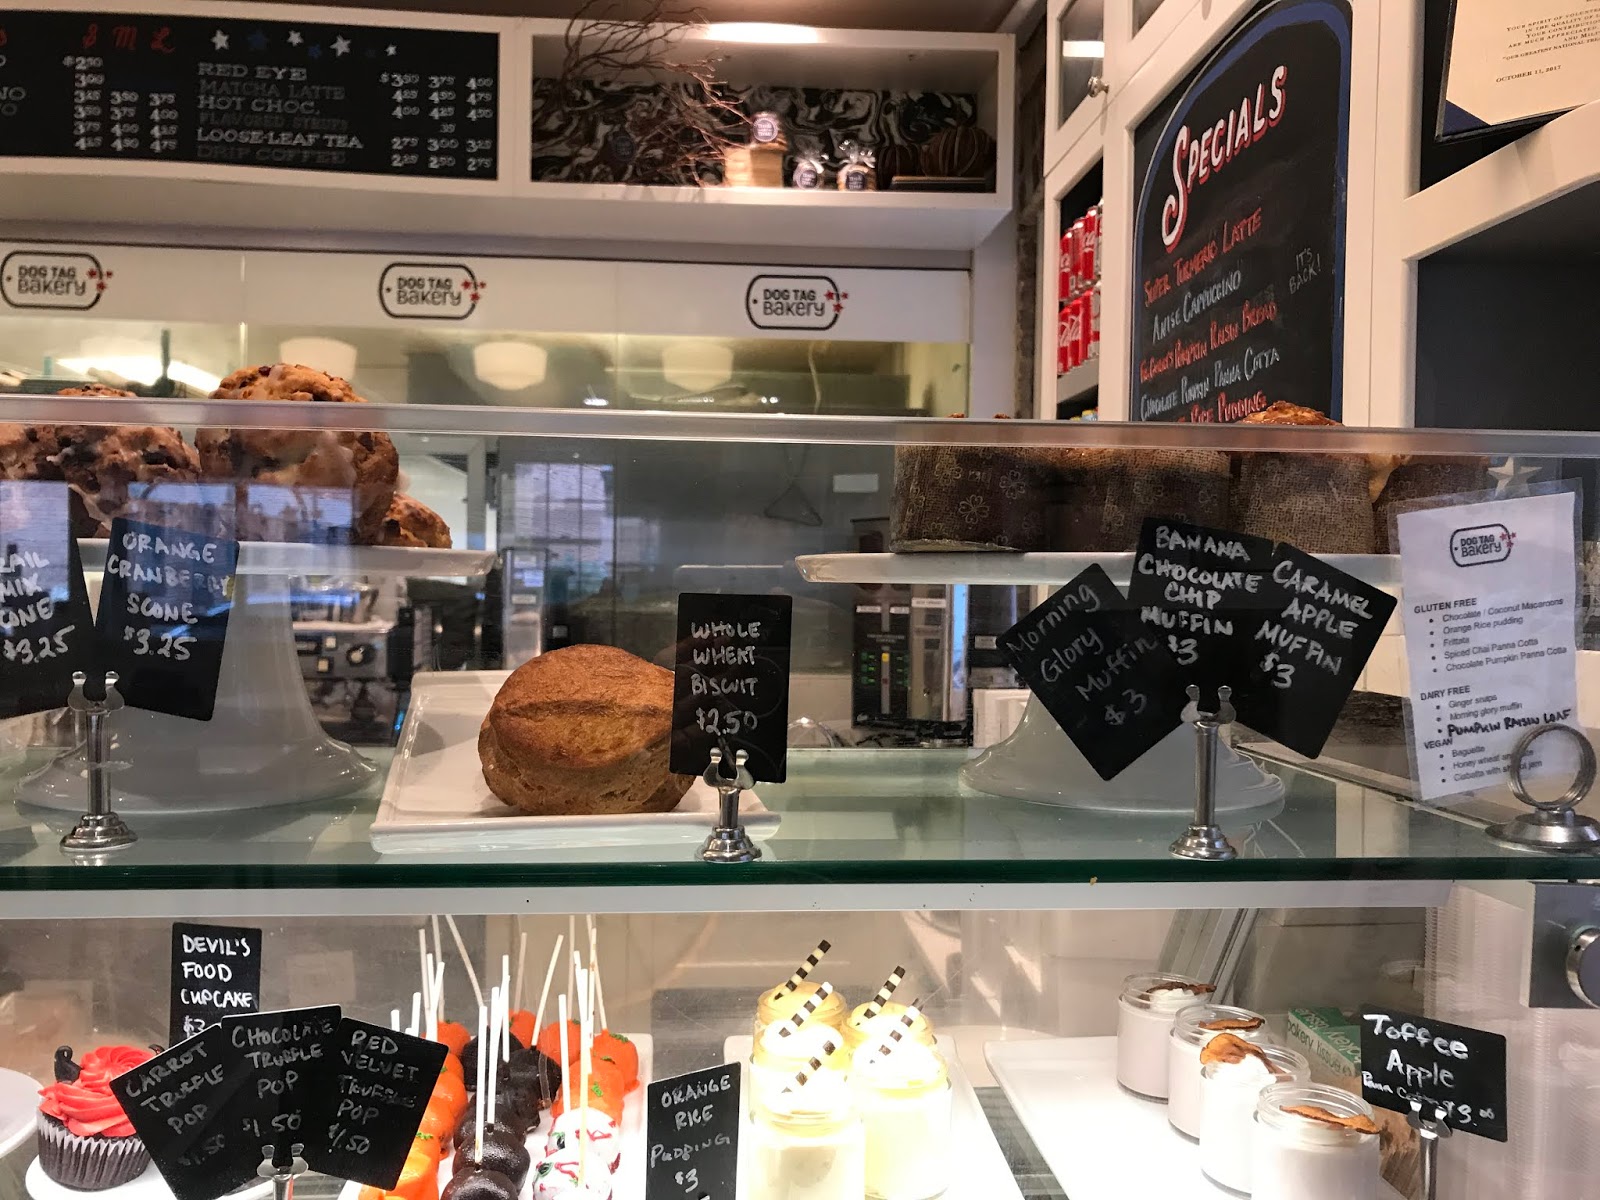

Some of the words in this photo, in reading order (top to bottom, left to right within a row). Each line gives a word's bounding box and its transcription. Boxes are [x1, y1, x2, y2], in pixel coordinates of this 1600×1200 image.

[197, 61, 248, 78] RED
[255, 65, 307, 81] EYE
[1496, 71, 1532, 83] OCTOBER
[1545, 65, 1561, 73] 2017
[197, 94, 245, 111] HOT
[199, 79, 281, 97] MATCHA
[288, 84, 346, 100] LATTE
[322, 133, 364, 149] TEA
[1162, 65, 1288, 253] SPECIALS
[1222, 207, 1262, 253] LATTE
[18, 265, 47, 278] DOG
[51, 266, 76, 280] TAG
[397, 277, 425, 290] DOG
[427, 278, 452, 290] TAG
[18, 279, 86, 296] Bakery
[396, 290, 461, 306] Bakery
[763, 289, 790, 301] DOG
[793, 290, 816, 301] TAG
[763, 301, 825, 316] Bakery
[1152, 310, 1181, 345] ANISE
[1244, 346, 1280, 382] COTTA
[122, 531, 218, 564] ORANGE
[1155, 525, 1251, 562] BANANA
[1460, 537, 1478, 546] DOG
[1479, 534, 1495, 544] TAG
[1461, 542, 1501, 557] Bakery
[1138, 553, 1263, 594] CHOCOLATE
[1164, 582, 1222, 610] CHIP
[1272, 559, 1374, 620] CARAMEL
[126, 592, 199, 625] SCONE
[1413, 601, 1451, 614] GLUTEN
[1453, 598, 1477, 609] FREE
[1442, 610, 1481, 622] Chocolate
[1487, 604, 1520, 616] Coconut
[1521, 598, 1564, 610] Macaroons
[690, 620, 761, 639] WHOLE
[1005, 582, 1100, 662] Morning
[1140, 605, 1234, 637] MUFFIN
[1281, 598, 1360, 641] APPLE
[1442, 624, 1472, 636] Orange
[1473, 619, 1492, 630] Rice
[1493, 616, 1524, 627] pudding
[3, 625, 76, 664] $3.25
[123, 625, 198, 661] $3.25
[1168, 634, 1199, 665] $3
[1254, 619, 1343, 677] MUFFIN
[1443, 637, 1470, 647] Frittata
[1444, 648, 1471, 660] Spiced
[1472, 643, 1490, 654] Chai
[1491, 641, 1516, 651] Panna
[1517, 637, 1539, 647] Cotta
[1039, 627, 1104, 684] Glory
[1075, 635, 1159, 702] Muffin
[1445, 660, 1484, 672] Chocolate
[1485, 654, 1519, 666] Pumpkin
[1520, 650, 1545, 660] Panna
[1546, 646, 1567, 655] Cotta
[1259, 652, 1296, 689] $3
[1420, 690, 1446, 701] DAIRY
[1447, 685, 1471, 696] FREE
[1448, 697, 1473, 709] Ginger
[1474, 694, 1498, 705] snaps
[695, 707, 758, 736] $2.50
[1447, 722, 1501, 737] PUMPKIN
[1503, 716, 1540, 730] RAISIN
[1543, 709, 1572, 723] LOAF
[1450, 708, 1479, 721] Morning
[1480, 705, 1499, 718] glory
[1499, 701, 1523, 711] muffin
[1424, 738, 1453, 749] VEGAN
[1452, 745, 1486, 758] Baguette
[1453, 758, 1476, 770] Honey
[1477, 753, 1501, 764] wheat
[1486, 764, 1501, 775] with
[1528, 760, 1543, 771] jam
[182, 934, 251, 957] DEVIL'S
[181, 962, 232, 983] FOOD
[180, 989, 253, 1009] CUPCAKE
[351, 1029, 399, 1055] RED
[1362, 1013, 1470, 1060] Toffee
[125, 1041, 209, 1098] CARROT
[244, 1043, 324, 1070] TRUFFLE
[341, 1050, 419, 1082] VELVET
[1386, 1048, 1456, 1089] Apple
[140, 1064, 224, 1113] TRUFFLE
[257, 1070, 299, 1099] POP
[661, 1074, 731, 1108] ORANGE
[167, 1103, 209, 1135] POP
[336, 1100, 380, 1125] POP
[675, 1104, 714, 1132] RICE
